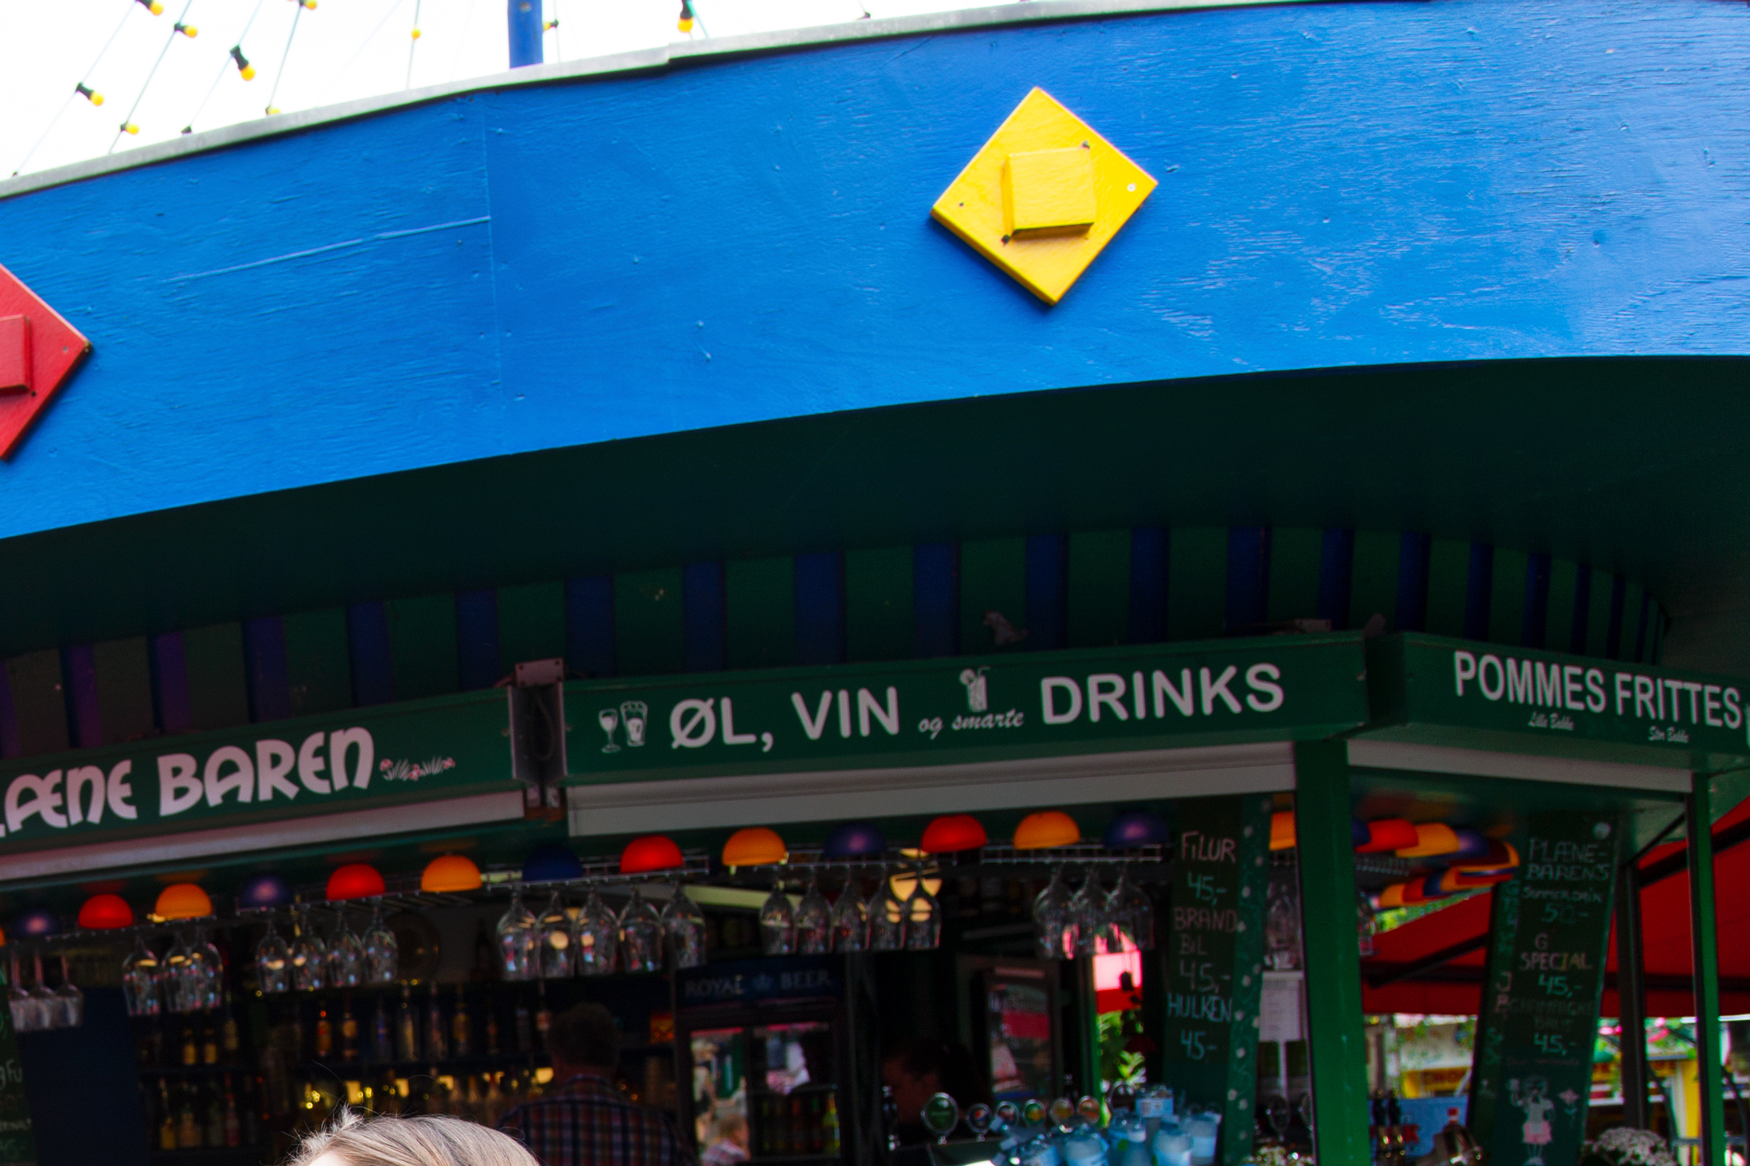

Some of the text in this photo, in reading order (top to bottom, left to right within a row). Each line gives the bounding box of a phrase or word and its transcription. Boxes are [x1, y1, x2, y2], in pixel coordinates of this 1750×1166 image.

[670, 663, 1284, 752] ØL, VIN og smarte DRINKS
[1454, 650, 1742, 729] POMMES FRITTES
[156, 726, 375, 817] BAREN
[780, 969, 830, 990] BEER
[1518, 952, 1593, 972] SPECIAL
